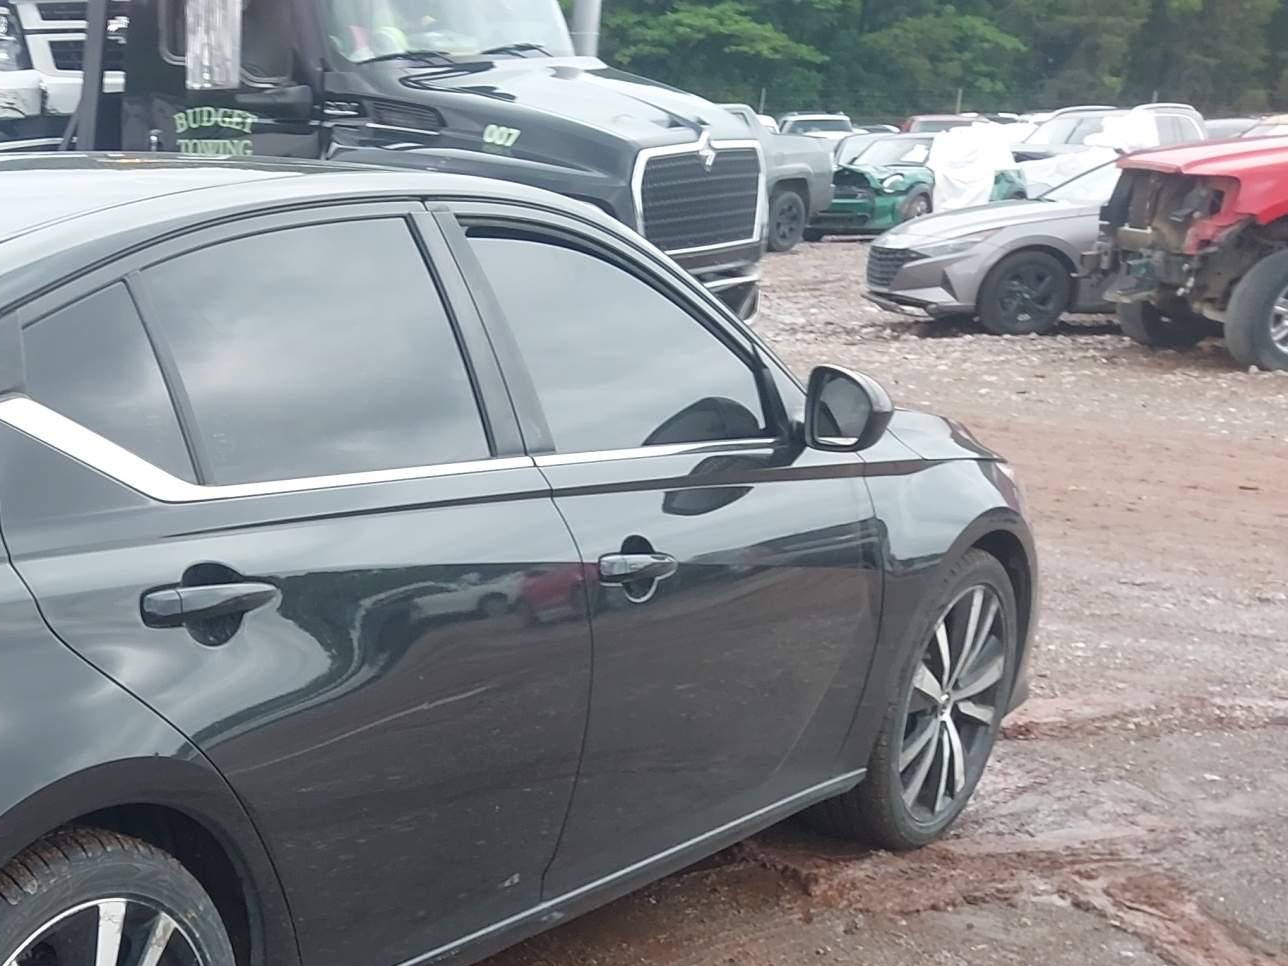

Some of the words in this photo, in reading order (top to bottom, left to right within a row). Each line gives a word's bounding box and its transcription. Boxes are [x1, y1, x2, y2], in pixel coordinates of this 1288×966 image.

[173, 106, 258, 133] BUDGET
[483, 124, 521, 147] 007
[176, 139, 254, 156] TOWING
